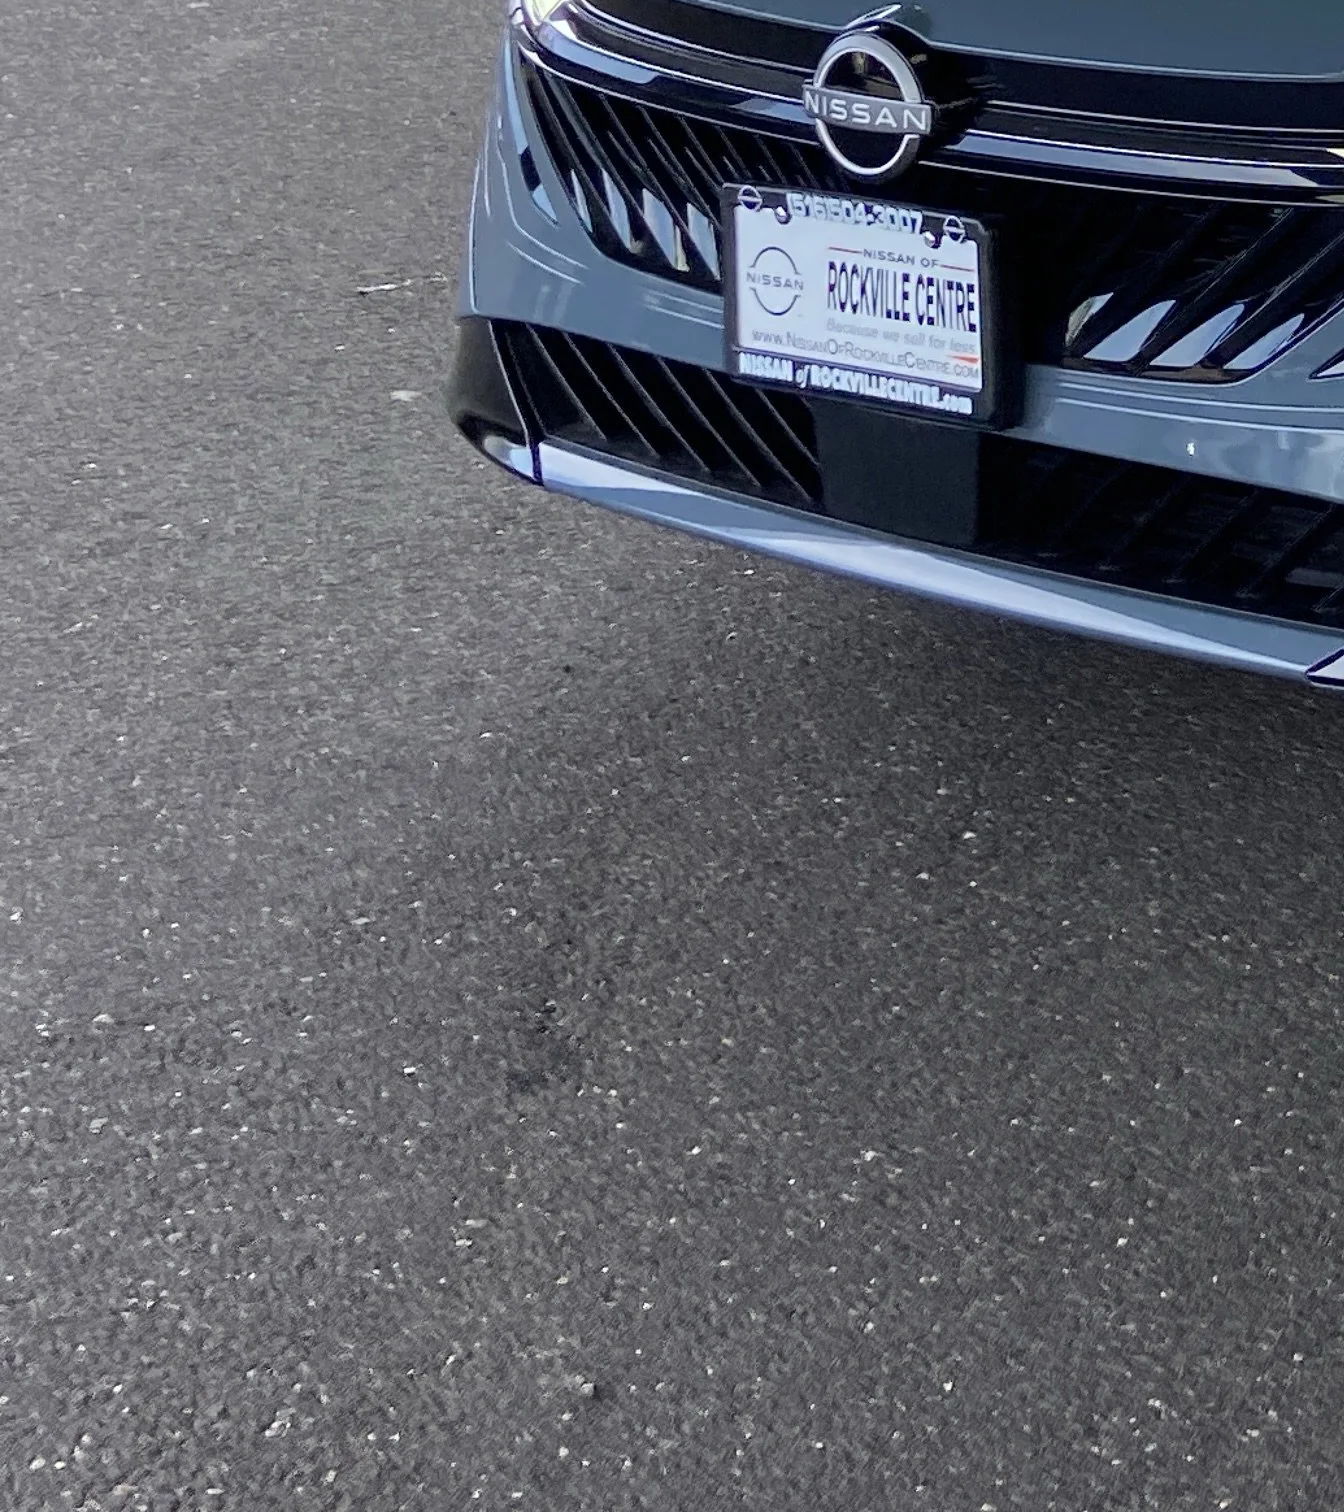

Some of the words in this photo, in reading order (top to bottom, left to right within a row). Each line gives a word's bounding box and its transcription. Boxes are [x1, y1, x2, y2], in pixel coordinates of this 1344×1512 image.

[804, 91, 928, 131] NISSAN
[863, 248, 915, 265] NISSAN
[920, 258, 939, 268] OF
[746, 272, 804, 291] NISSAN
[827, 261, 909, 321] ROCKVILLE
[915, 274, 976, 332] CENTRE
[739, 352, 793, 382] NISSAN
